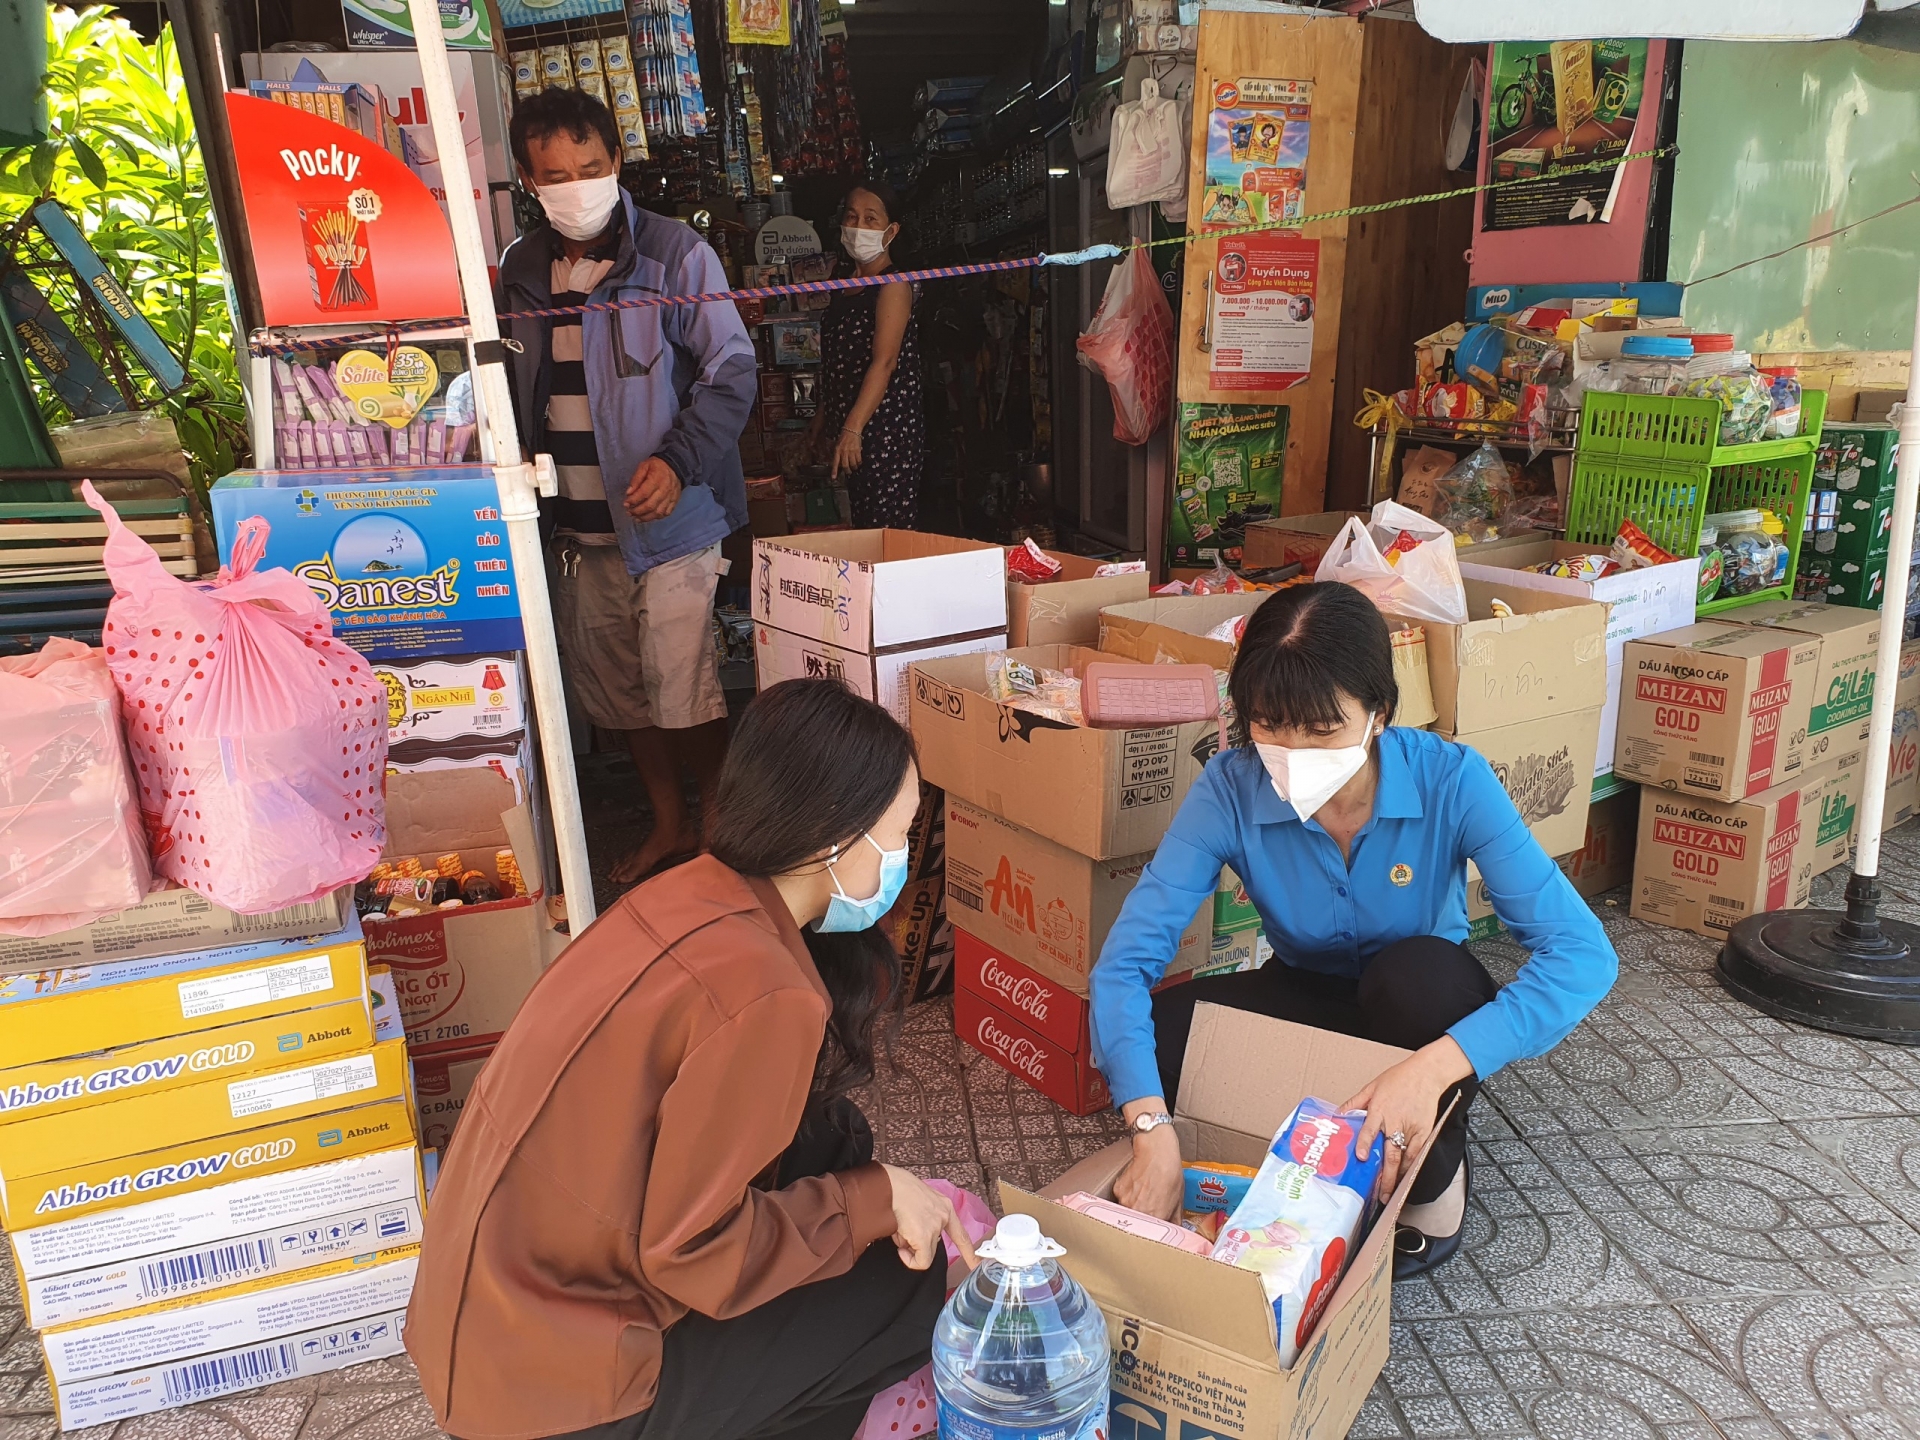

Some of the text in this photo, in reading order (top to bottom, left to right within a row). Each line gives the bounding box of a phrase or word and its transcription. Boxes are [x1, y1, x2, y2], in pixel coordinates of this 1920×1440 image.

[353, 29, 385, 41] whisper
[1565, 48, 1588, 69] MILO
[266, 82, 290, 90] HALLS
[318, 84, 341, 92] HALLS
[1288, 81, 1297, 93] 2
[355, 194, 375, 209] SỐ 1
[763, 247, 784, 255] Dinh
[1251, 267, 1310, 279] Tuyển Dụng
[1485, 294, 1507, 305] MILO
[341, 367, 385, 384] Solite
[1189, 429, 1218, 439] NHẬN
[1219, 425, 1240, 435] QUÀ
[1251, 457, 1261, 469] 2
[418, 488, 437, 497] GIA
[1228, 492, 1237, 503] 3
[475, 507, 498, 521] YẾN
[477, 533, 500, 546] ĐẢO
[475, 559, 507, 572] THIÊN
[296, 563, 455, 609] Sanest
[477, 584, 510, 597] NHIÊN
[344, 614, 364, 625] YẾN
[390, 611, 423, 622] KHÁNH
[426, 610, 447, 620] HÒA
[1706, 669, 1729, 682] CẤP
[1640, 680, 1723, 709] MEIZAN
[1752, 684, 1789, 709] MEIZAN
[1655, 707, 1700, 732] GOLD
[1827, 701, 1868, 723] COOKING OIL
[1756, 712, 1777, 736] GOLD
[1130, 731, 1150, 740] thùng
[1132, 755, 1168, 769] CAO CẤP
[1547, 745, 1569, 772] Stick
[1131, 766, 1168, 781] KHĂN ĂN
[958, 815, 978, 829] ORION
[994, 817, 1020, 833] MA2
[1724, 816, 1747, 829] CẤP
[1657, 824, 1742, 855] MEIZAN
[1769, 825, 1800, 854] MEIZAN
[1673, 851, 1718, 876] GOLD
[1770, 857, 1789, 879] GOLD
[224, 916, 325, 935] 5 391523 059572
[239, 946, 258, 954] CAO
[407, 944, 440, 954] FOODS
[1225, 946, 1250, 963] DƯỠNG
[101, 969, 128, 978] HƠN
[131, 963, 159, 973] MINH
[426, 971, 450, 989] ỚT
[182, 990, 209, 1000] 11896
[980, 958, 1052, 1022] Coca-Cola
[405, 993, 437, 1007] NGỌT
[185, 1003, 224, 1016] 214100459
[307, 1026, 352, 1044] Abbott
[406, 1023, 470, 1044] PET 270G
[977, 1016, 1050, 1083] Coca-Cola
[89, 1057, 184, 1092] GROW
[189, 1043, 252, 1071] GOLD
[231, 1089, 257, 1101] 12127
[233, 1103, 272, 1116] 214100459
[347, 1122, 390, 1139] Abbott
[1304, 1118, 1340, 1168] HUGGIES
[37, 1140, 294, 1212] Abbott GROW GOLD
[1289, 1176, 1305, 1200] sinh
[1196, 1195, 1214, 1203] KINH
[302, 1240, 350, 1256] XIN TAY
[381, 1242, 421, 1257] Abbott
[41, 1271, 126, 1294] Abbott GROW GOLD
[136, 1293, 142, 1301] 5
[151, 1280, 207, 1298] 099864
[215, 1264, 270, 1284] 010169
[356, 1343, 371, 1351] TAY
[68, 1376, 151, 1399] Abbott GROW GOLD
[160, 1368, 291, 1406] 5 099864 010169
[1143, 1361, 1247, 1408] PHẨM PEPSICO VIỆT NAM
[1198, 1371, 1247, 1394] Sản phẩm của
[1115, 1374, 1130, 1388] Thủ
[1132, 1380, 1148, 1395] Dầu
[1150, 1387, 1168, 1404] Một,
[1192, 1405, 1211, 1420] Bình
[1214, 1413, 1244, 1432] Dương
[1144, 1373, 1153, 1386] số
[1156, 1381, 1164, 1391] 2,
[1166, 1385, 1184, 1398] KCN
[1187, 1391, 1209, 1409] Sóng
[1213, 1400, 1233, 1415] Thần
[1236, 1410, 1245, 1420] 3,
